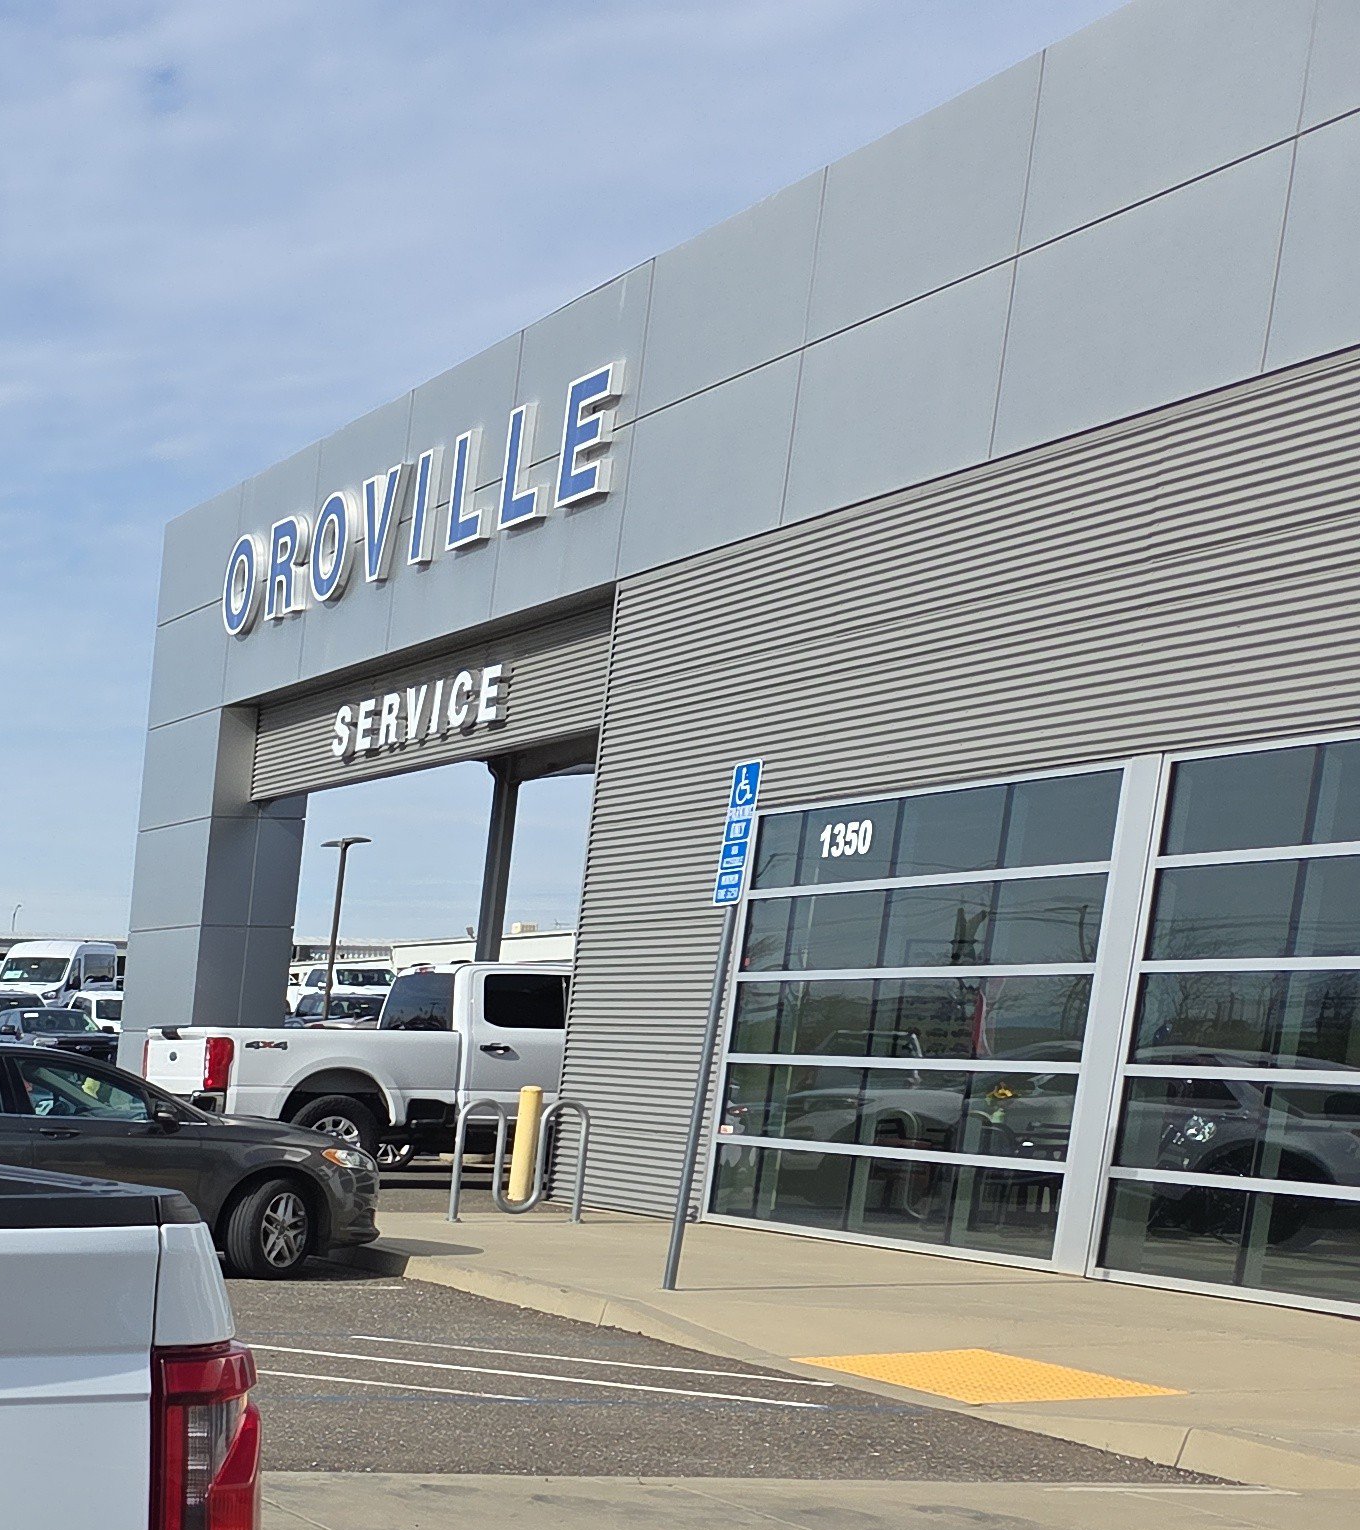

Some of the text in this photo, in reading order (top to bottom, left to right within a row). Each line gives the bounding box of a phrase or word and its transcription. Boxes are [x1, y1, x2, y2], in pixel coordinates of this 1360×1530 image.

[221, 360, 624, 636] OROVILLE
[331, 664, 503, 757] SERVICE
[820, 819, 873, 858] 1350
